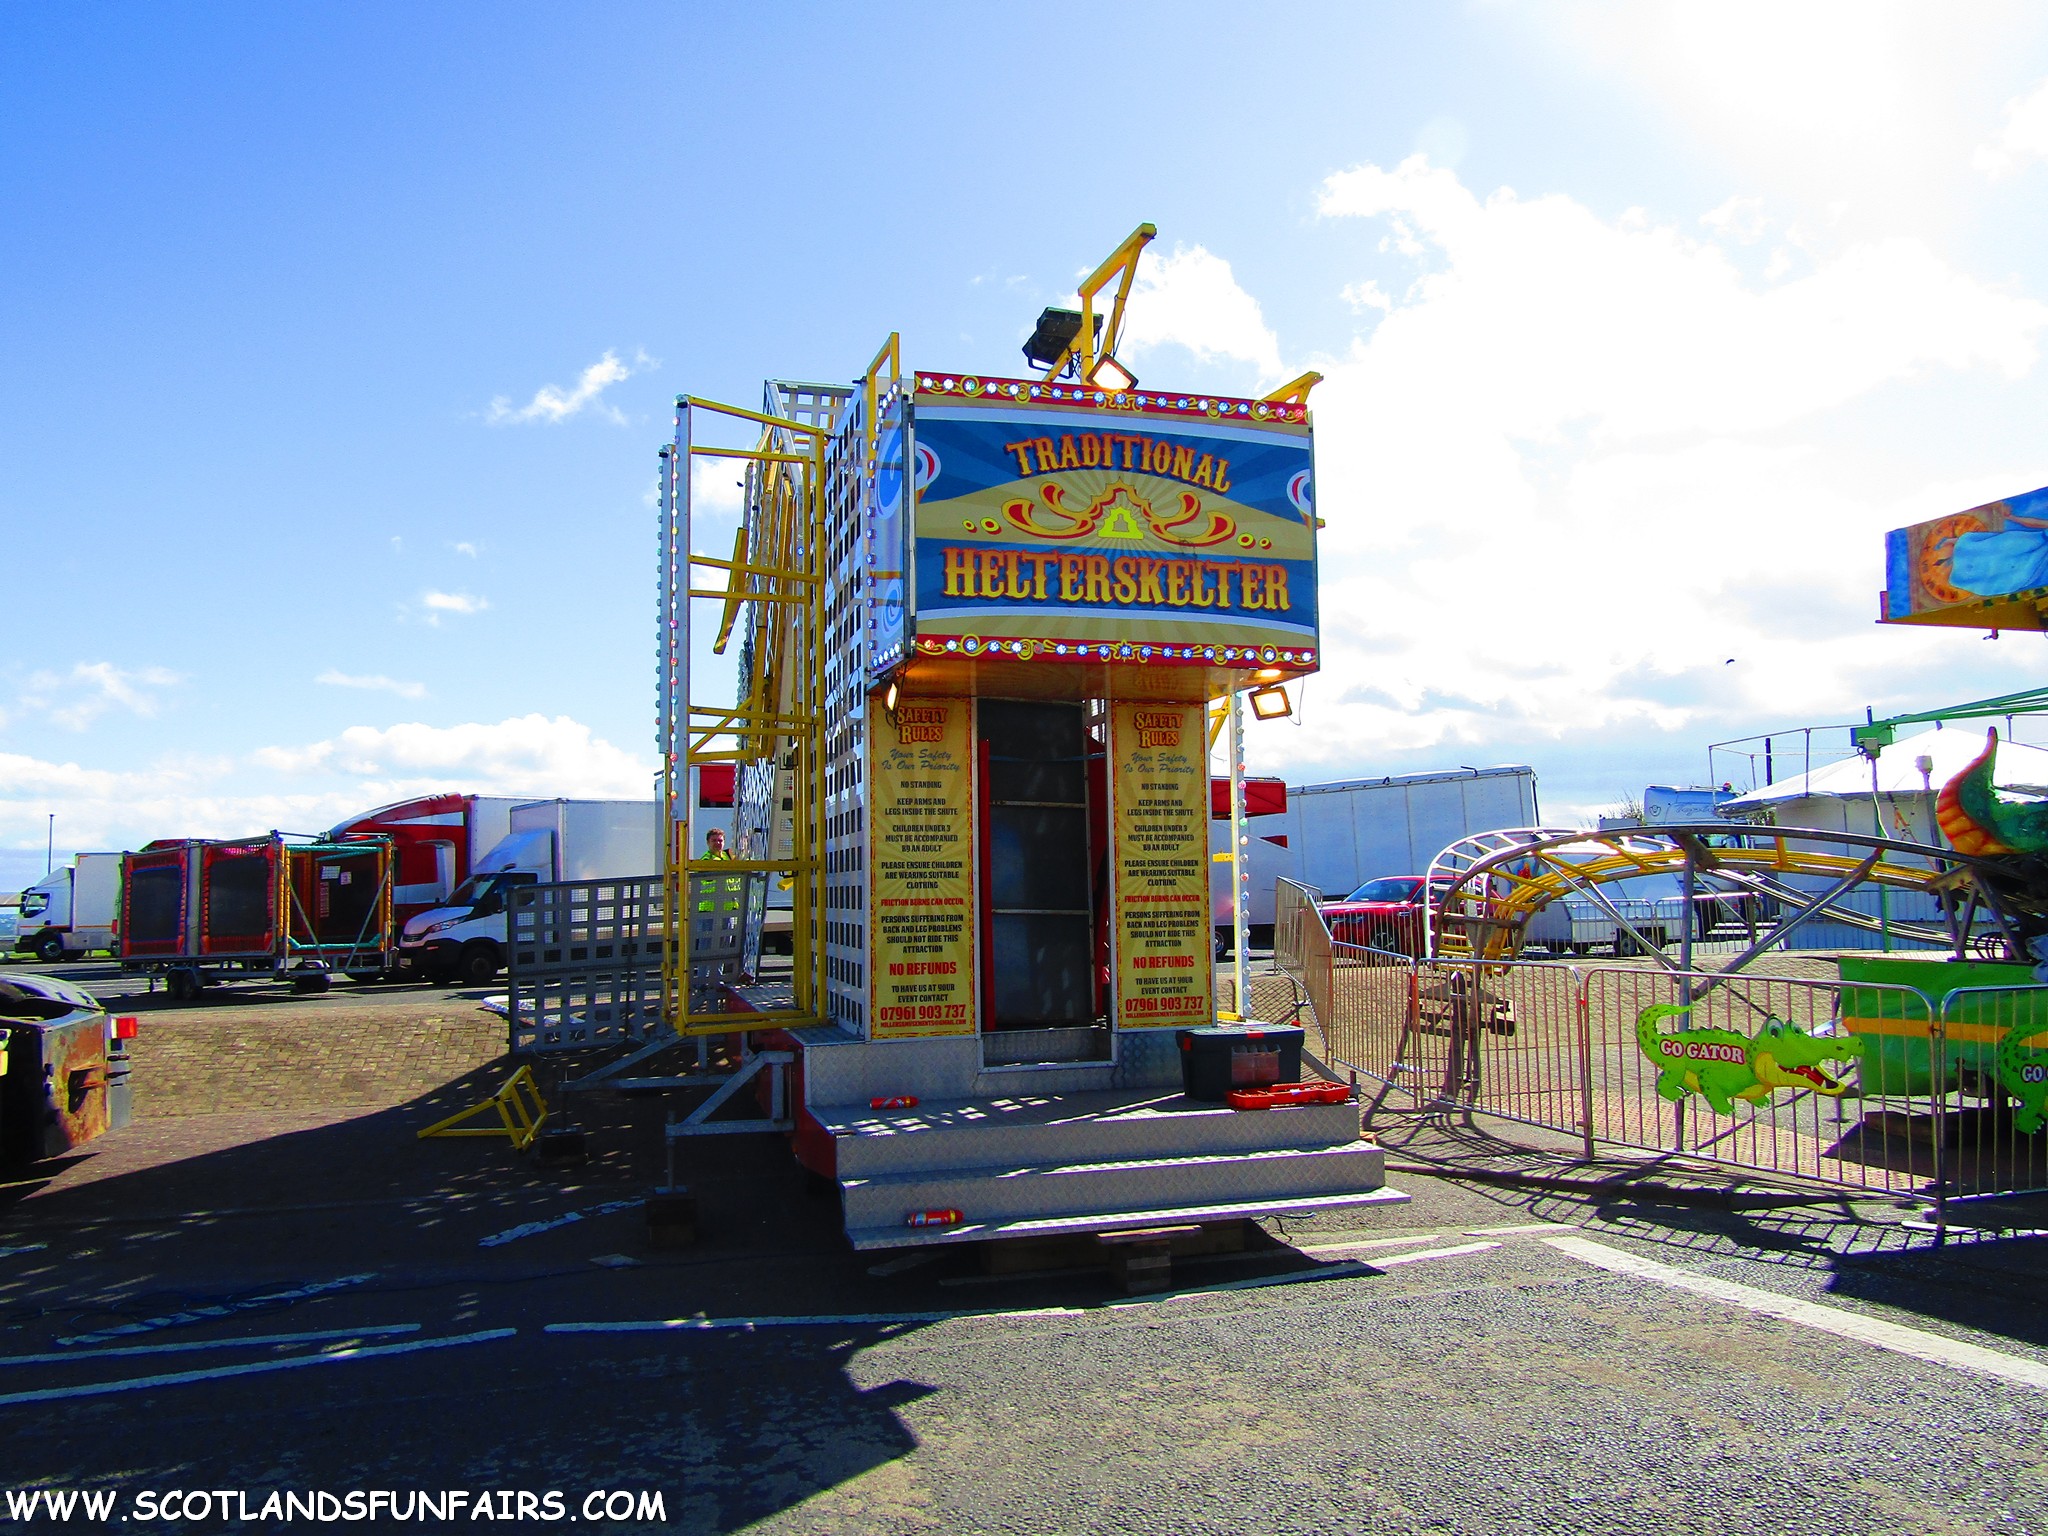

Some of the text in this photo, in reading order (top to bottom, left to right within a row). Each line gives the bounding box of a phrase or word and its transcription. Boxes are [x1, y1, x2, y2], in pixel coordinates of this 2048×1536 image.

[1006, 433, 1230, 494] TRADITIONAL
[943, 548, 1290, 611] HELTERSKELTER
[897, 707, 948, 724] SAFETY
[1135, 712, 1183, 729] SAFETY
[900, 725, 943, 743] RULES
[1140, 730, 1179, 748] RULES
[890, 749, 952, 760] Your Safety
[1131, 753, 1187, 763] Your Safety
[882, 760, 960, 772] Is Our Priority
[1124, 764, 1195, 774] Is Our Priority
[885, 835, 903, 843] MUST
[901, 925, 914, 933] AND
[890, 962, 957, 975] NO REFUNDS
[1133, 956, 1194, 968] NO REFUNDS
[1142, 986, 1187, 995] EVENT CONTACT
[919, 994, 948, 1002] CONTACT
[1126, 996, 1203, 1012] 07961 903 737
[880, 1004, 966, 1020] 07961 903 737
[1660, 1040, 1745, 1064] GO GATOR
[2021, 1065, 2043, 1082] GO
